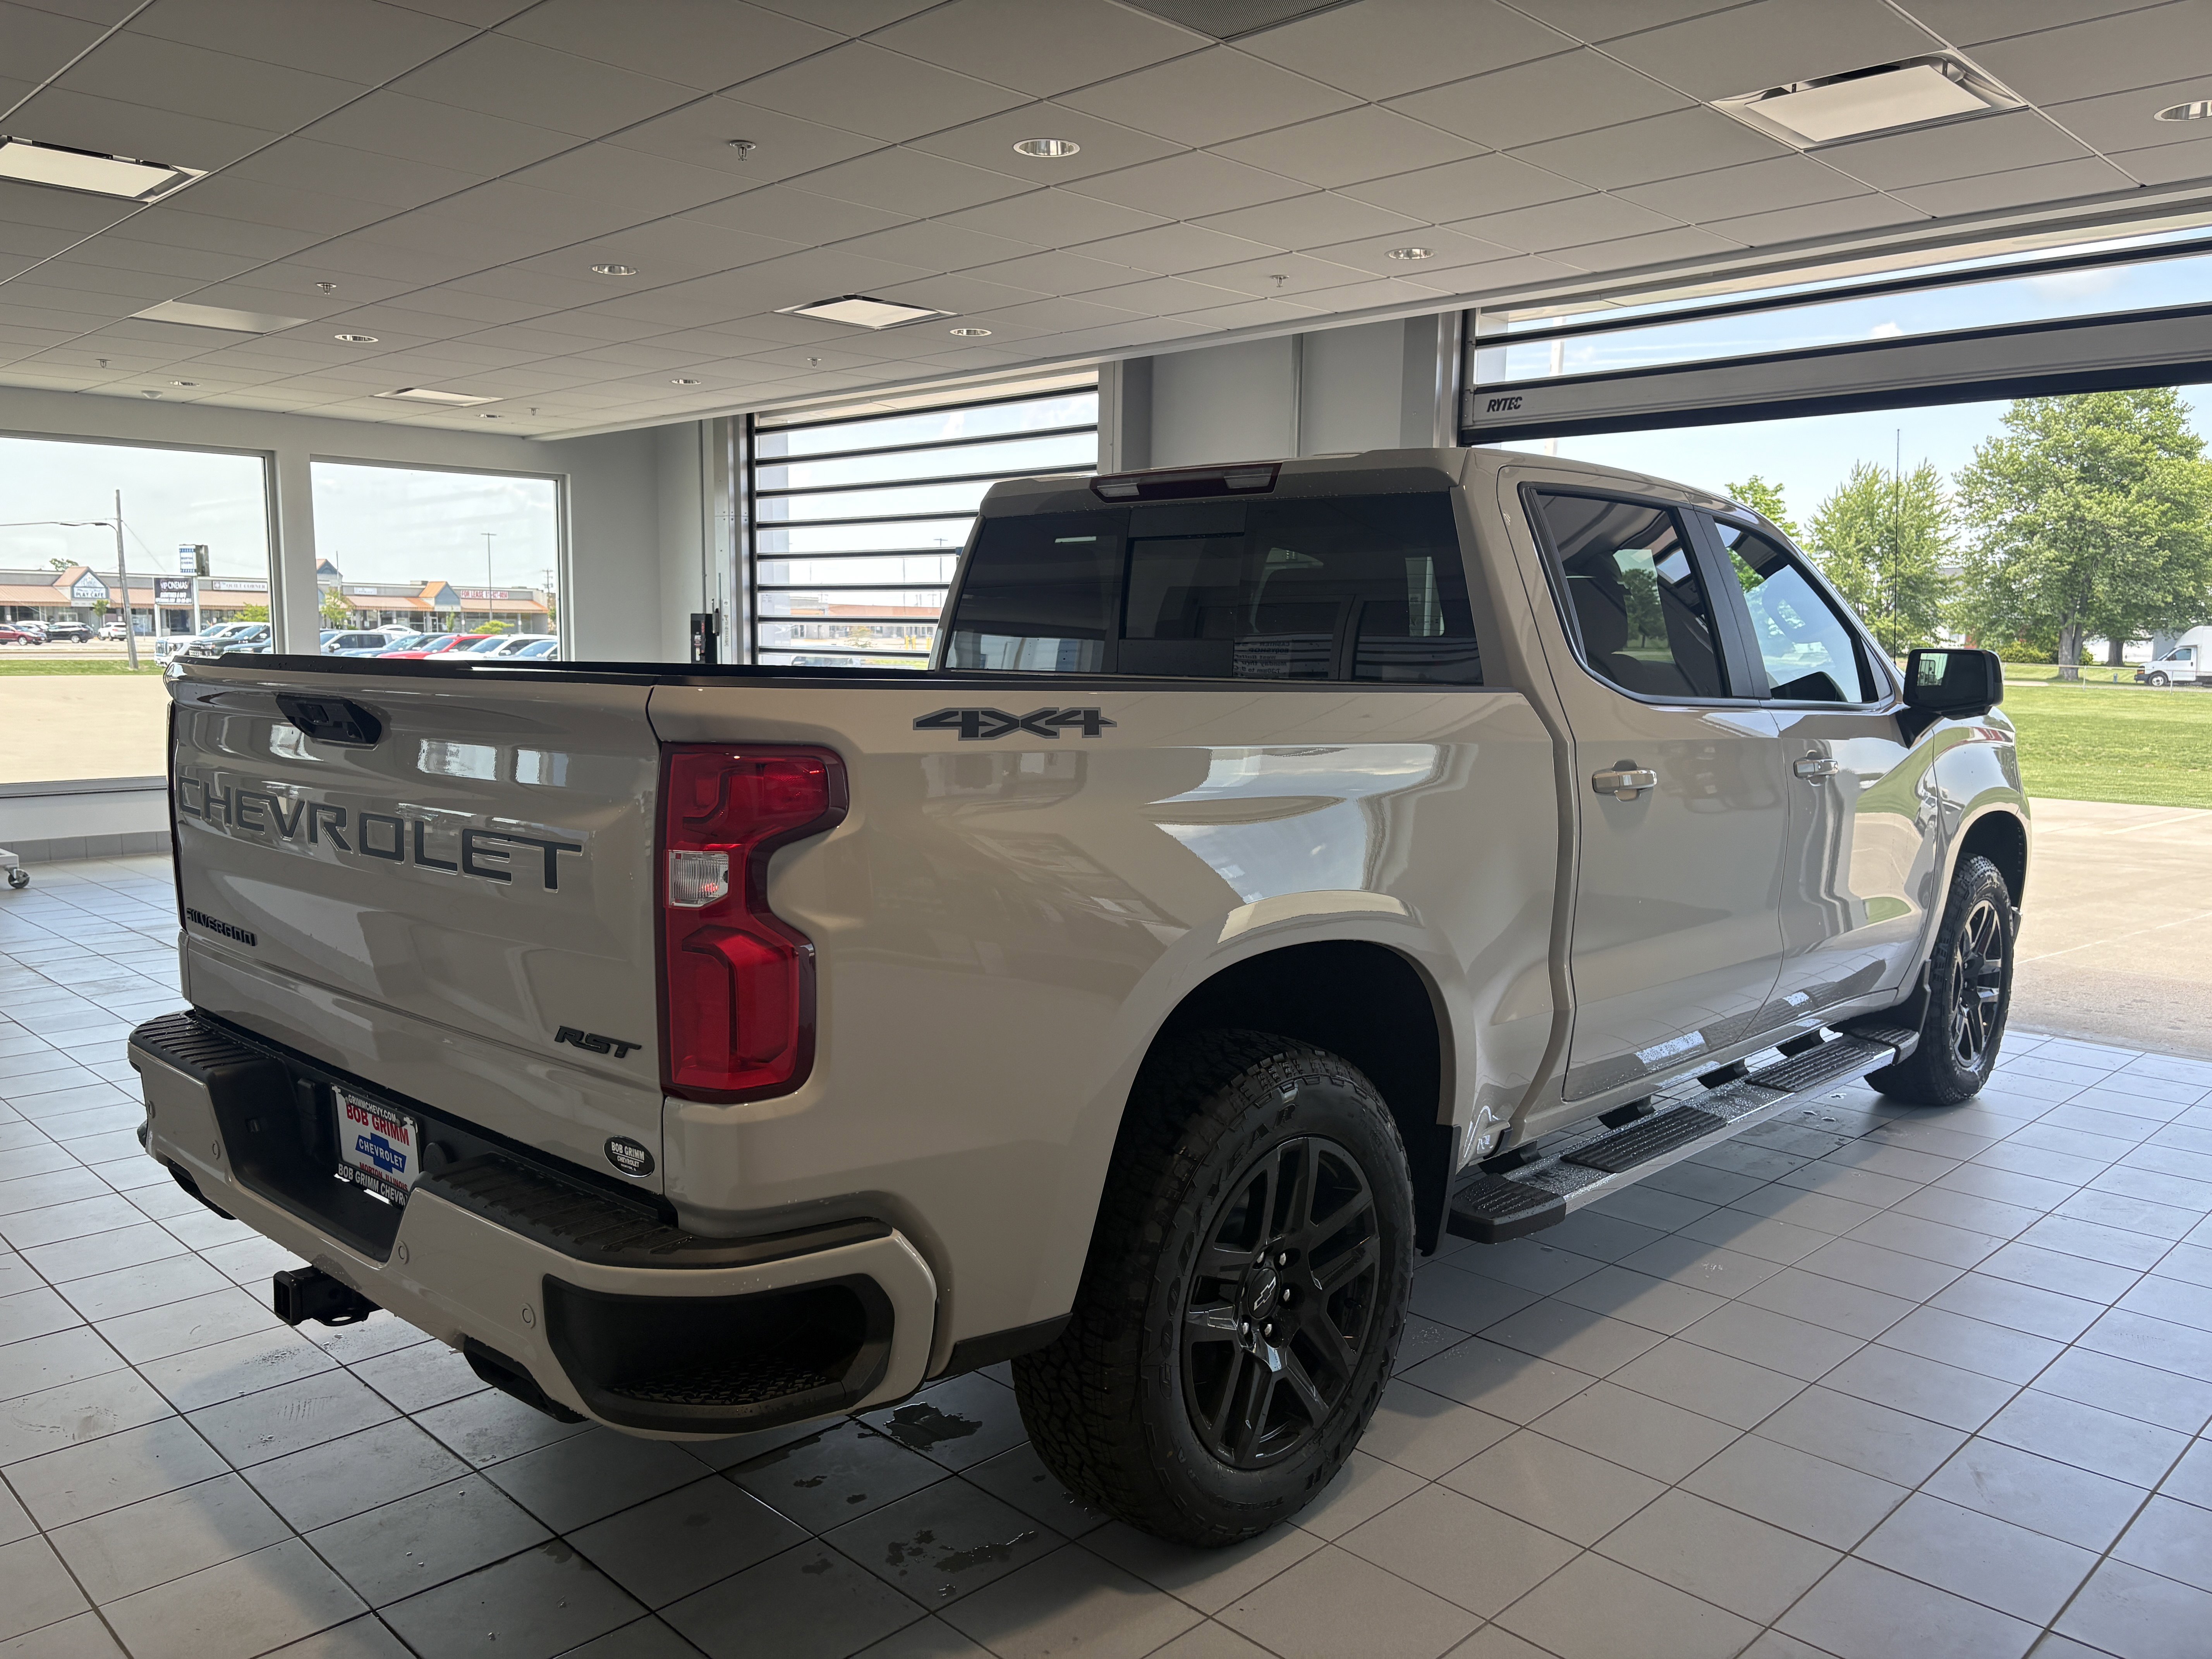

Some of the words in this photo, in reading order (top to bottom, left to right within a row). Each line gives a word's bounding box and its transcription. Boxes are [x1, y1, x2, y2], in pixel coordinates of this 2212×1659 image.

[1487, 396, 1523, 412] RYTEC
[179, 776, 582, 892] CHEVROLET
[186, 907, 258, 946] SILVERADO
[554, 1025, 642, 1058] RST
[348, 1094, 397, 1122] GRIMMCHEVY.COM
[346, 1104, 369, 1126] BOB
[372, 1115, 410, 1146] GRIMM
[359, 1139, 403, 1168] CHEVROLET
[611, 1141, 623, 1154] BOB
[624, 1146, 644, 1161] GRIMM
[617, 1156, 640, 1168] CHEVROLET
[338, 1163, 353, 1180] BOB
[356, 1171, 379, 1193] GRIMM
[385, 1173, 407, 1190] ILLINOIS
[1158, 1102, 1297, 1405] GOODYEAR
